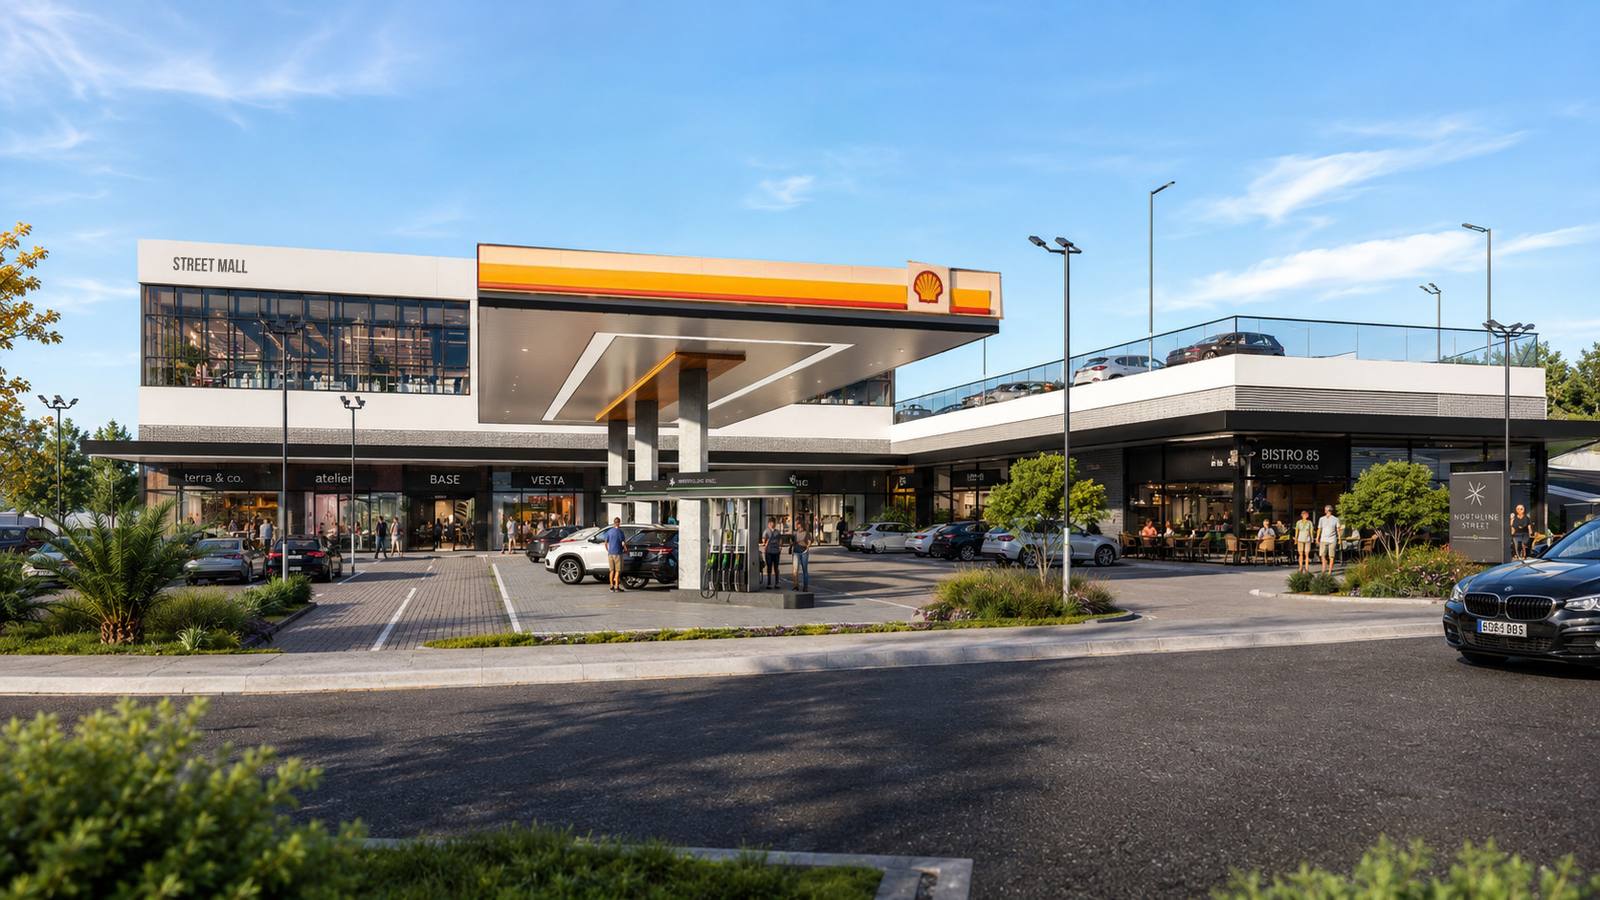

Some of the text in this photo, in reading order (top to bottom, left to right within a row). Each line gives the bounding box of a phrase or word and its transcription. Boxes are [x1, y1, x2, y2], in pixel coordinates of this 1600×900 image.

[172, 256, 248, 274] STREET MALL
[1261, 448, 1320, 461] BISTRO 85
[184, 472, 244, 483] terra & co.
[315, 472, 353, 483] atelier
[430, 474, 461, 485] BASE
[531, 475, 566, 485] VESTA
